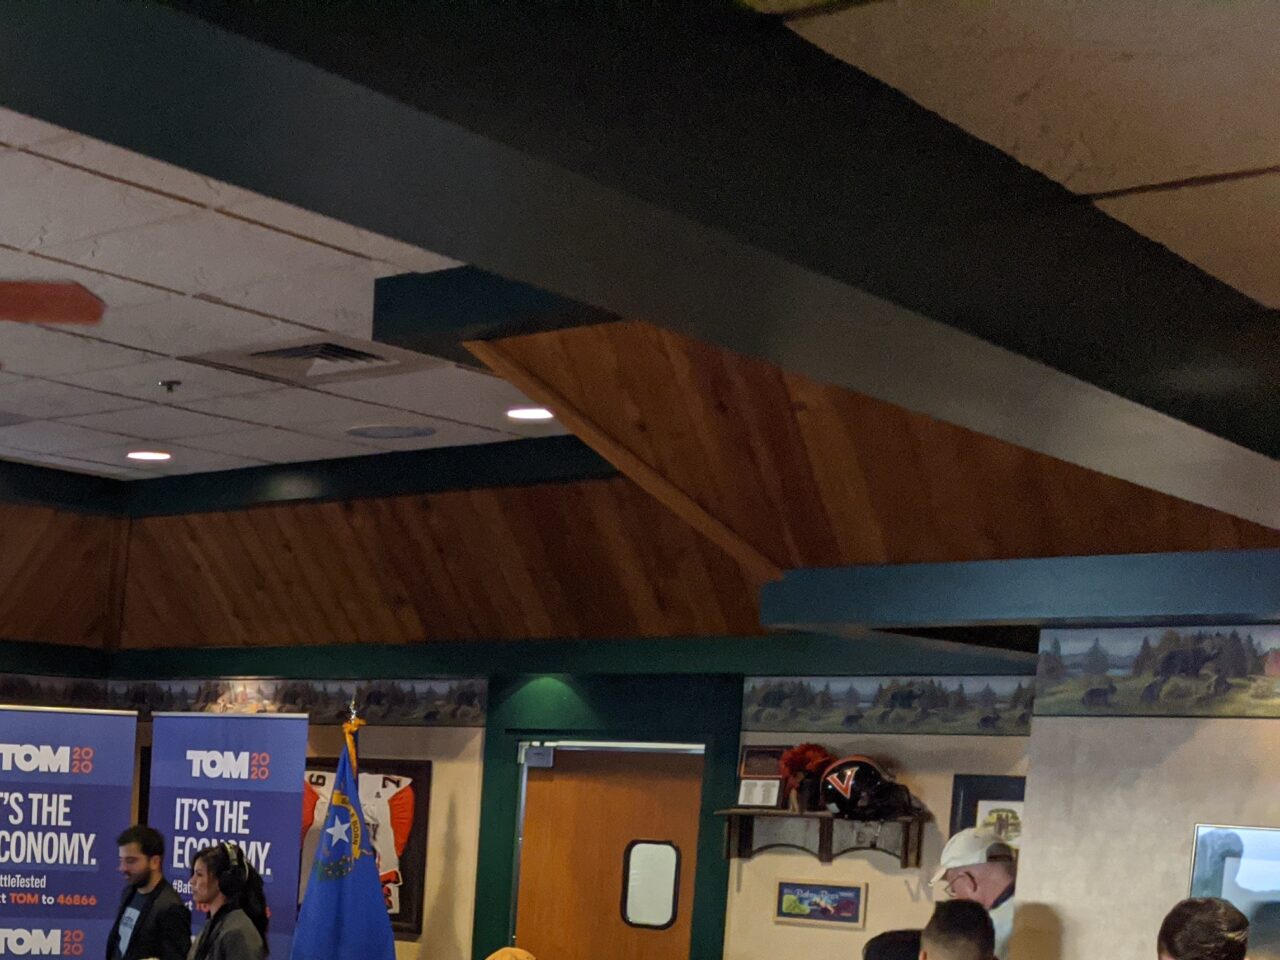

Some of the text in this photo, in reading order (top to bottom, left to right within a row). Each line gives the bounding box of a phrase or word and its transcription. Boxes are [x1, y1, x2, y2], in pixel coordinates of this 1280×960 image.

[186, 750, 250, 779] TOM
[28, 793, 72, 826] THE
[174, 798, 251, 834] IT'S THE
[10, 893, 39, 904] TOM
[41, 893, 55, 905] to
[56, 894, 97, 906] 46866
